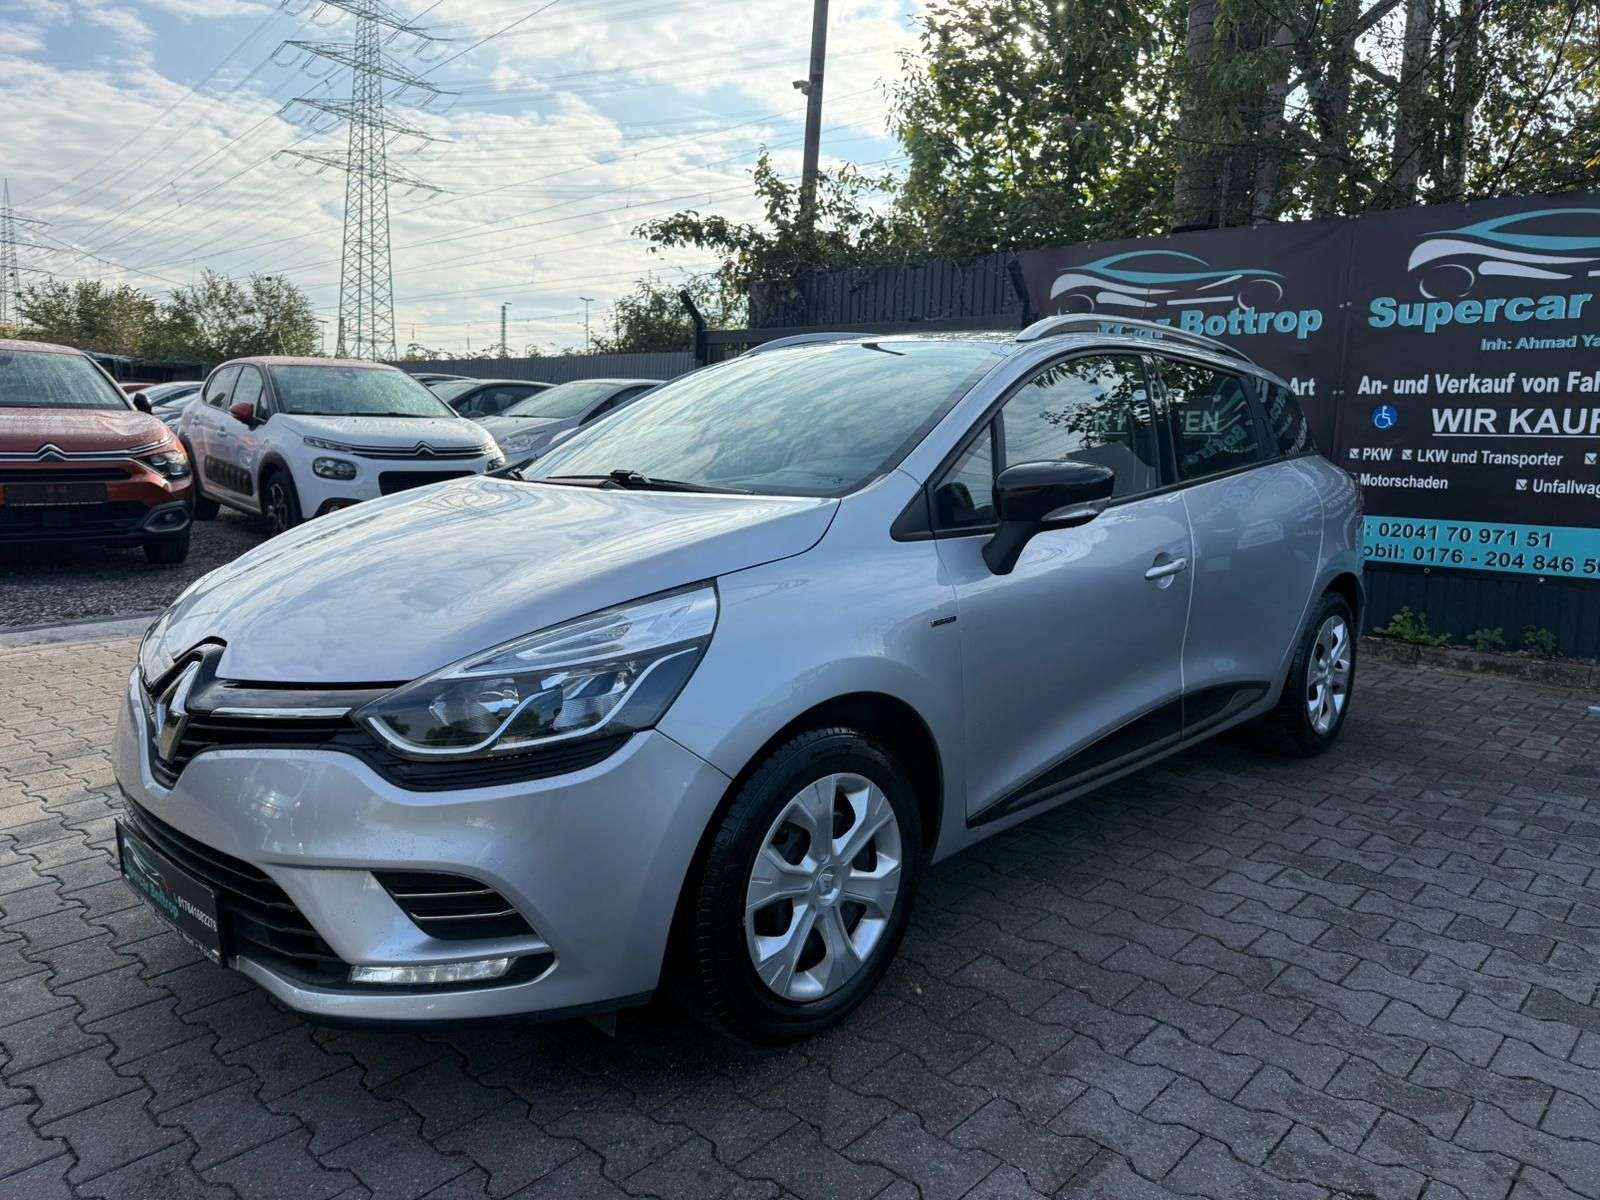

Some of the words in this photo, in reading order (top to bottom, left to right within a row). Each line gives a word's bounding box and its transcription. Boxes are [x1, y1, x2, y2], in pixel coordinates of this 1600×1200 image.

[1180, 307, 1323, 339] Bottrop
[1368, 293, 1593, 333] Supercar
[1481, 338, 1512, 351] Inh:
[1515, 335, 1577, 350] Ahmad
[1290, 377, 1315, 395] Art
[1357, 375, 1388, 395] An-
[1393, 374, 1429, 394] und
[1435, 372, 1516, 394] Verkauf
[1521, 376, 1559, 393] von
[1432, 408, 1497, 433] WIR
[1362, 448, 1393, 461] PKW
[1417, 449, 1448, 463] LKW
[1451, 450, 1477, 464] und
[1481, 450, 1564, 468] Transporter
[1360, 473, 1448, 489] Motorschaden
[1378, 523, 1439, 541] 02041
[1447, 527, 1472, 543] 70
[1478, 528, 1518, 547] 971
[1526, 531, 1553, 549] 51
[1363, 543, 1405, 559] obil:
[1413, 546, 1464, 564] 0176
[1484, 551, 1524, 569] 204
[1532, 554, 1575, 573] 846
[1582, 558, 1600, 575] 5
